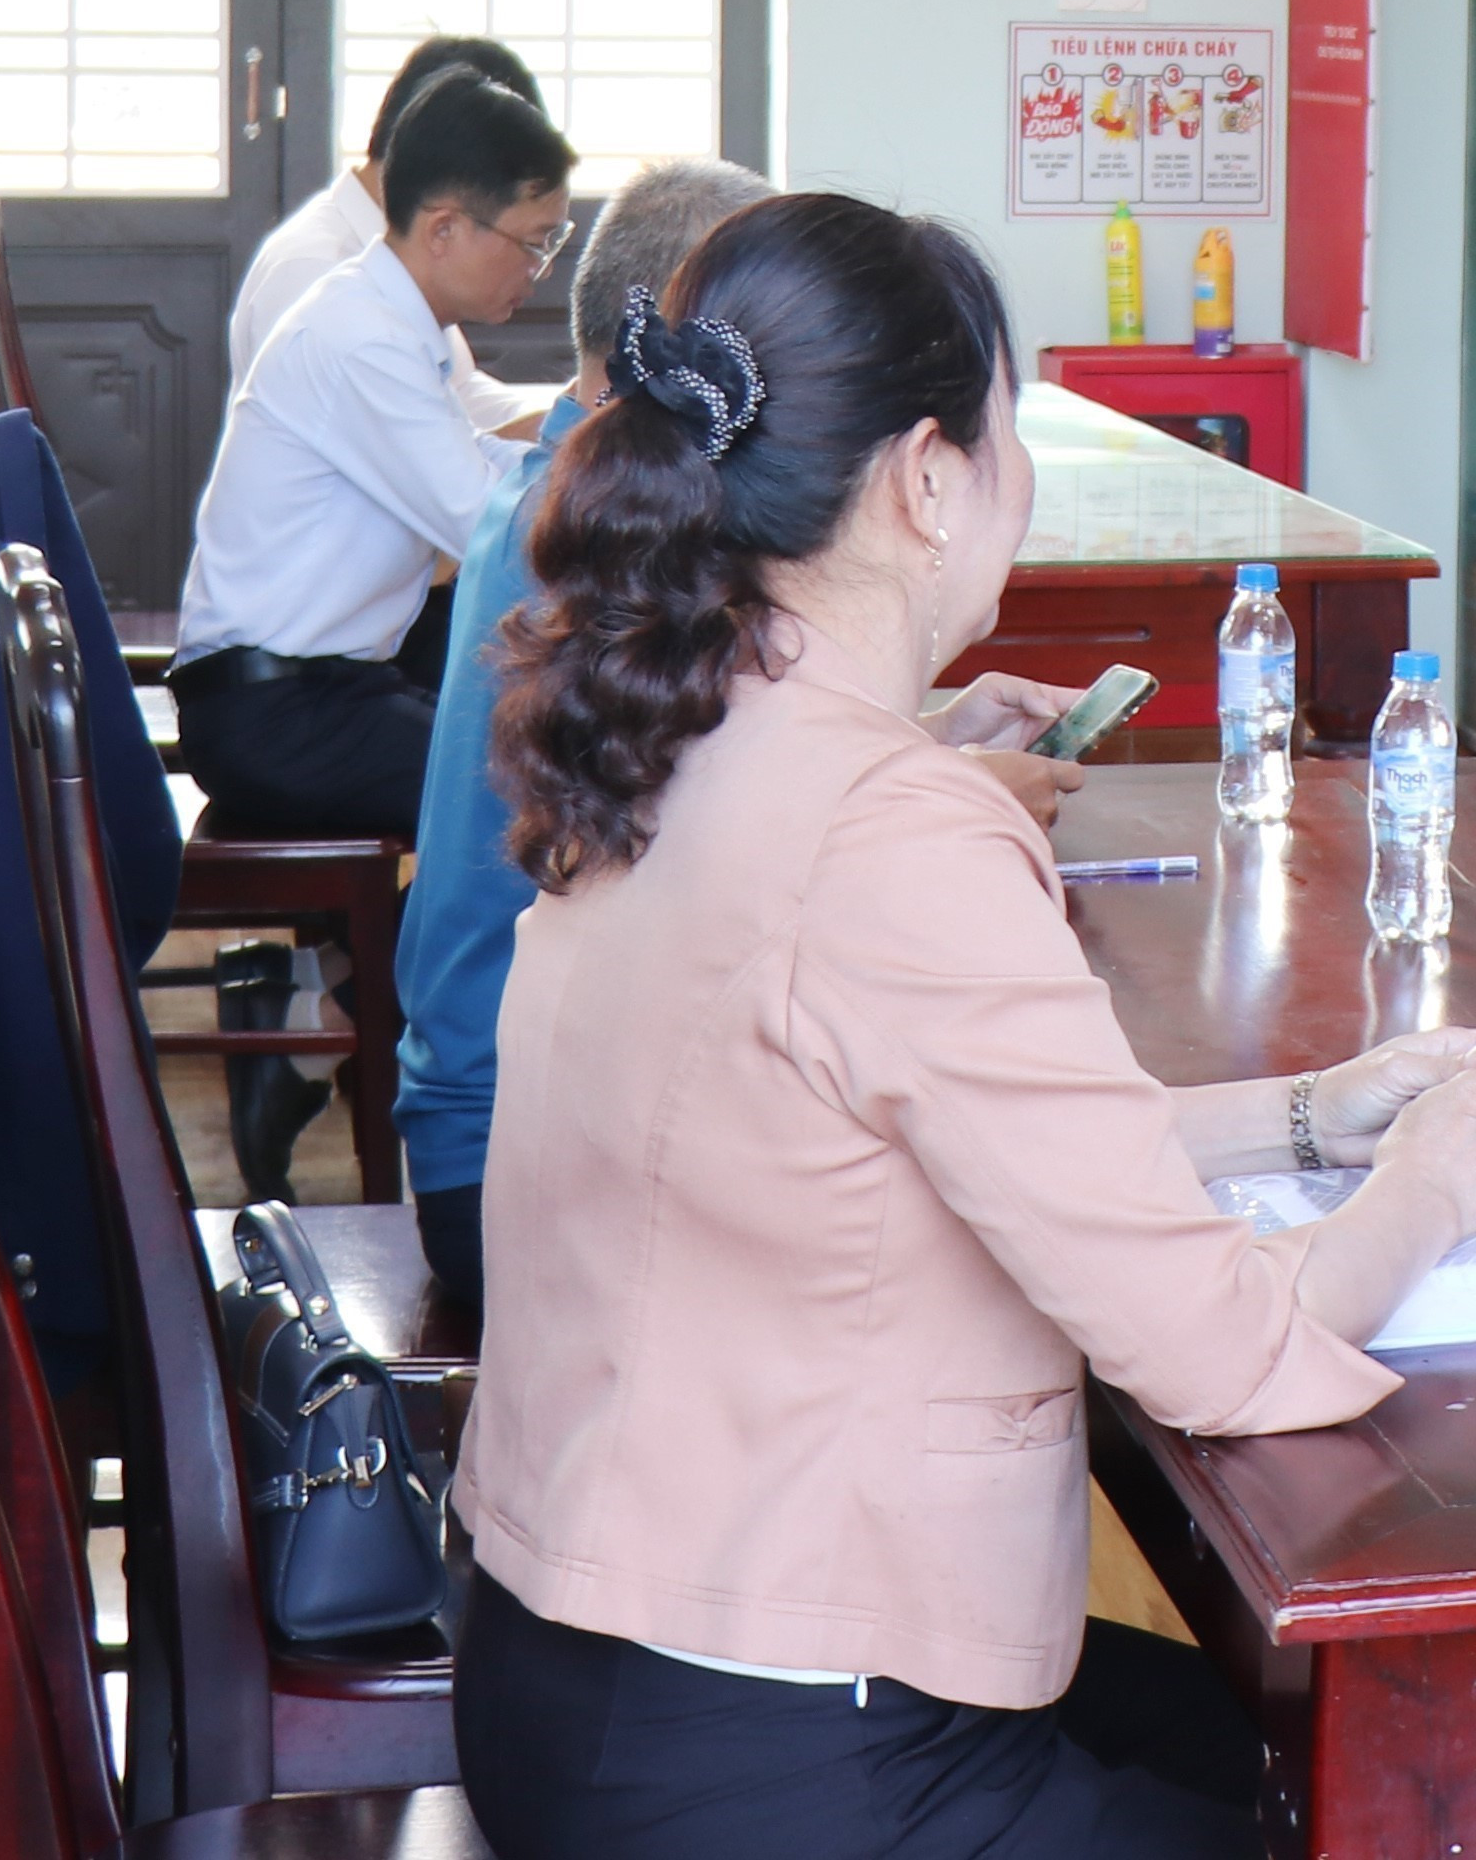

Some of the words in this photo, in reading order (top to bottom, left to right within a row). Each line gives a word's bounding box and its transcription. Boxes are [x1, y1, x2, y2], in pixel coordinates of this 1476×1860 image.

[1194, 38, 1237, 58] CHÁY
[1047, 67, 1058, 82] 1
[1108, 66, 1121, 82] 2
[1167, 68, 1181, 83] 3
[1226, 69, 1241, 83] 4
